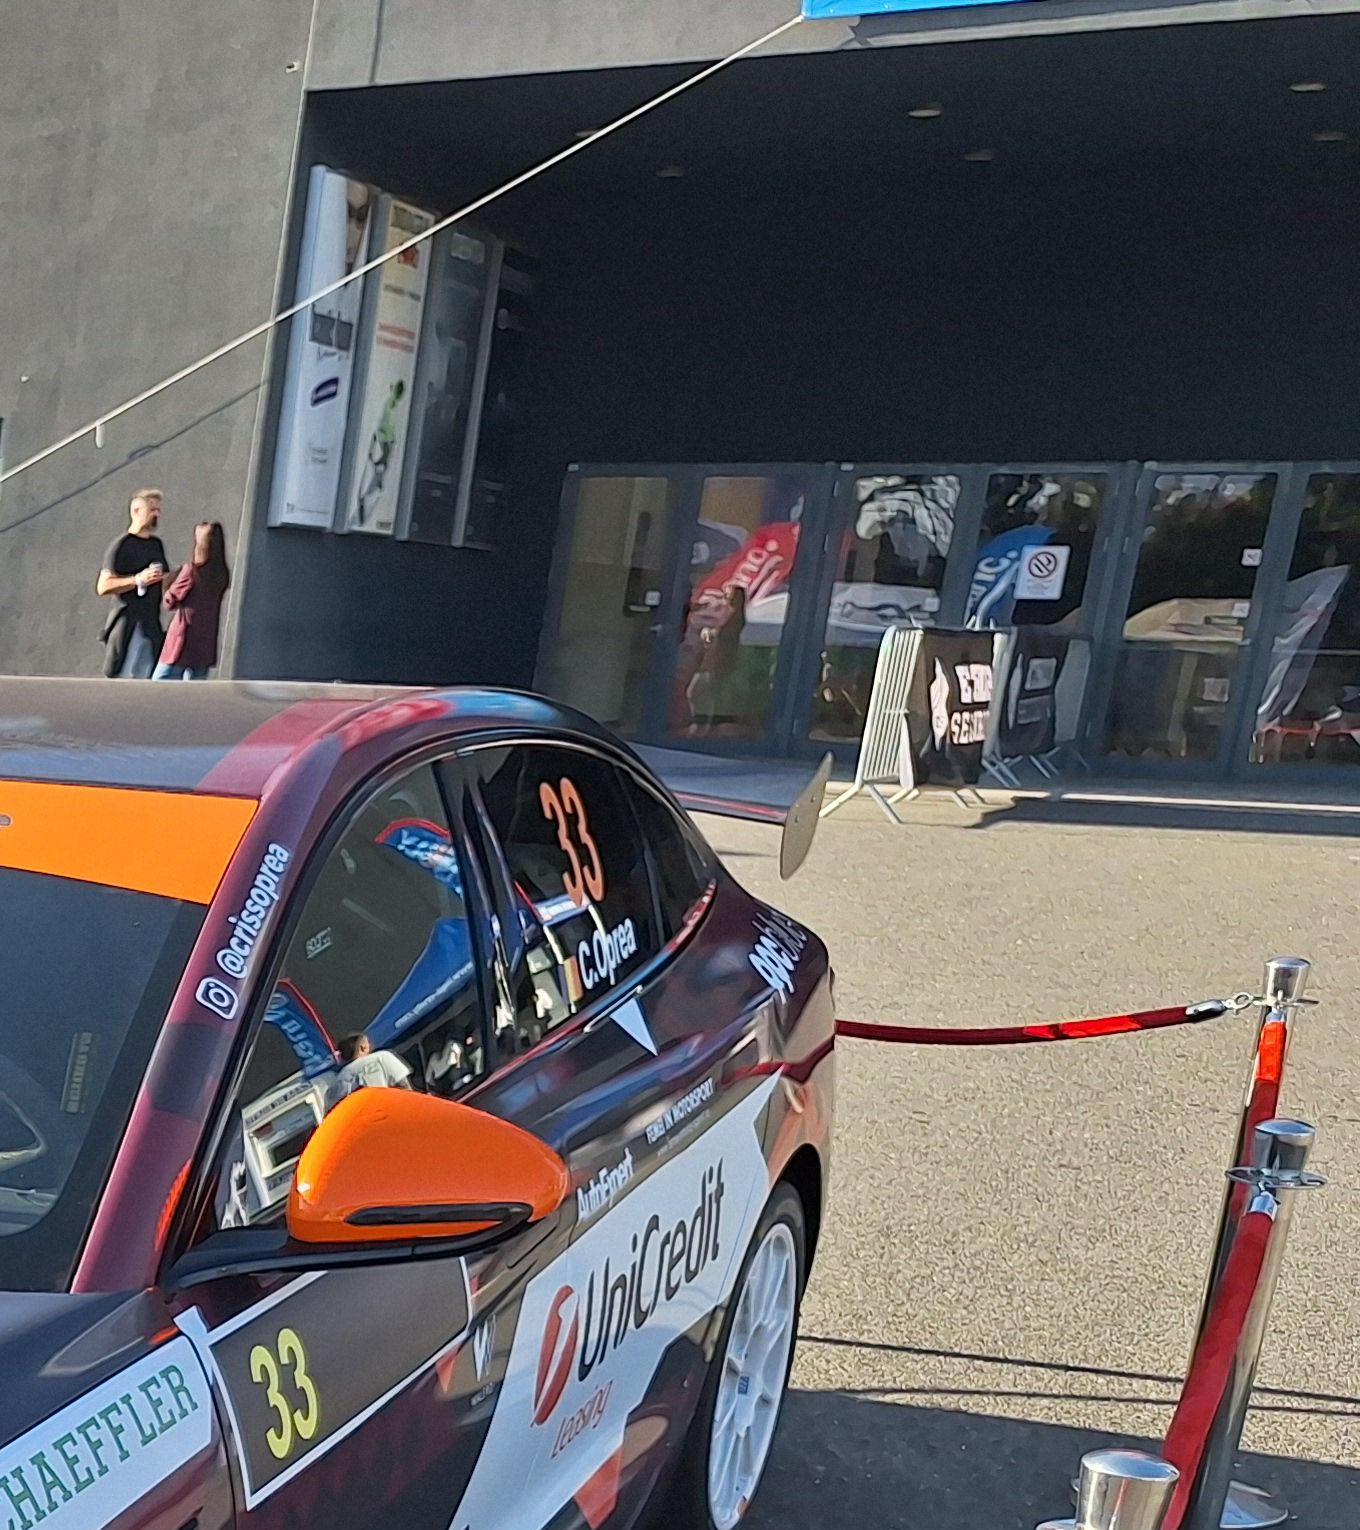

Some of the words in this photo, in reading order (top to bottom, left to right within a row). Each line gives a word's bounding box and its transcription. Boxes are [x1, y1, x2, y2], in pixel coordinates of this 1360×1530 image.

[539, 776, 606, 907] 33
[215, 842, 290, 980] @crissoprea
[578, 917, 637, 990] C.Oprea
[578, 1157, 725, 1382] UniCredit
[249, 1328, 320, 1460] 33
